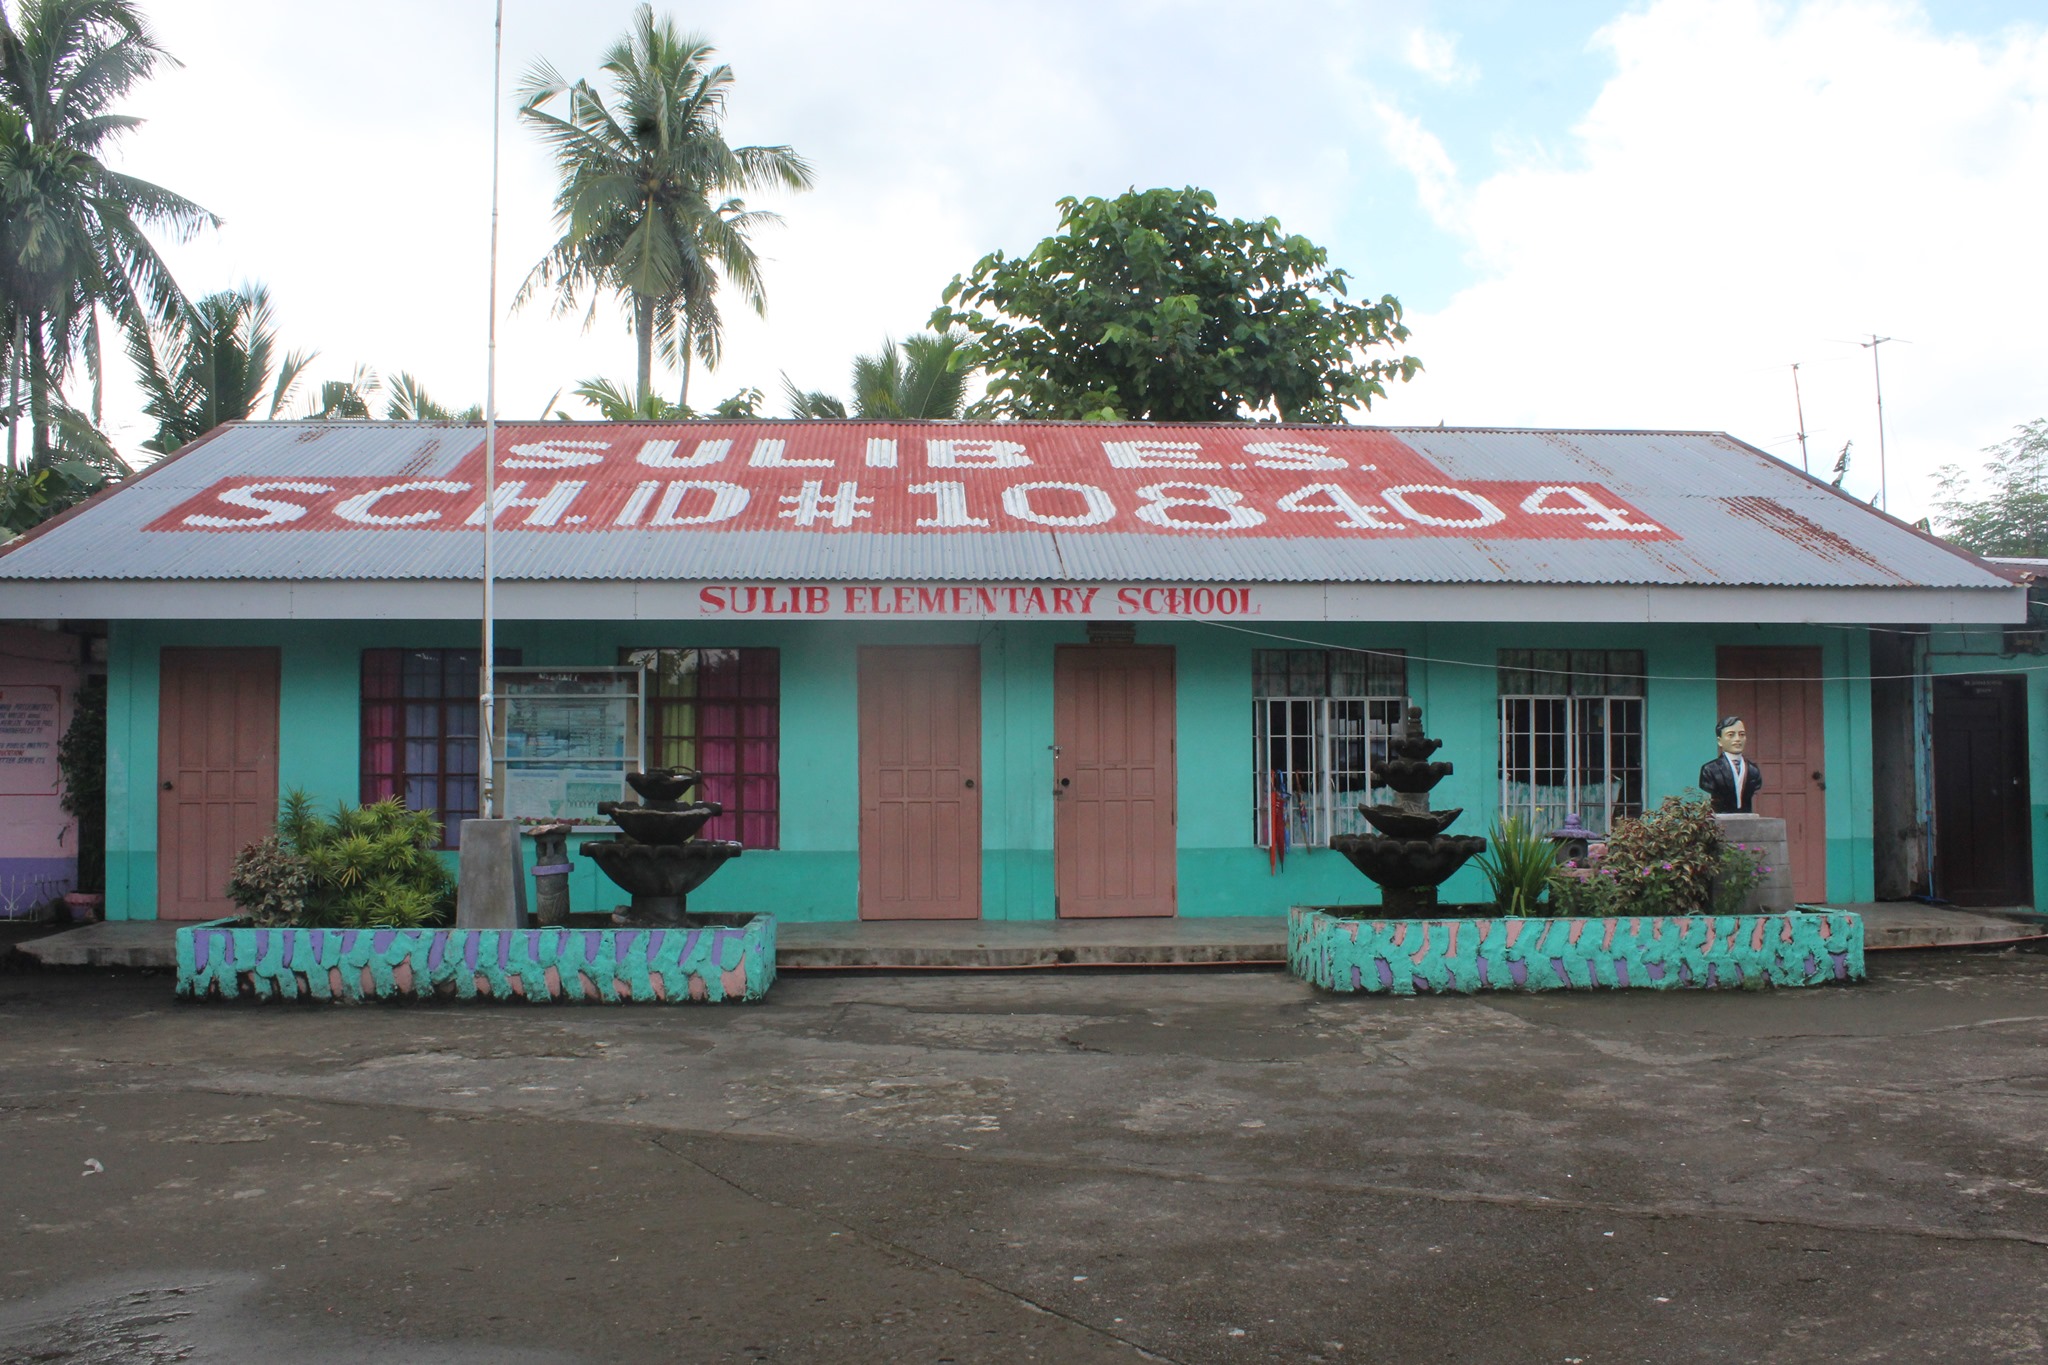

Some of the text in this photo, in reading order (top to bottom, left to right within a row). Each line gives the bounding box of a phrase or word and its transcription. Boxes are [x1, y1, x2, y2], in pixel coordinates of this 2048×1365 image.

[501, 438, 1377, 471] SULIB E.S.
[182, 480, 1662, 534] SCH. ID # 108404
[699, 585, 1261, 616] SULIB ELEMENTARY SCHOOL
